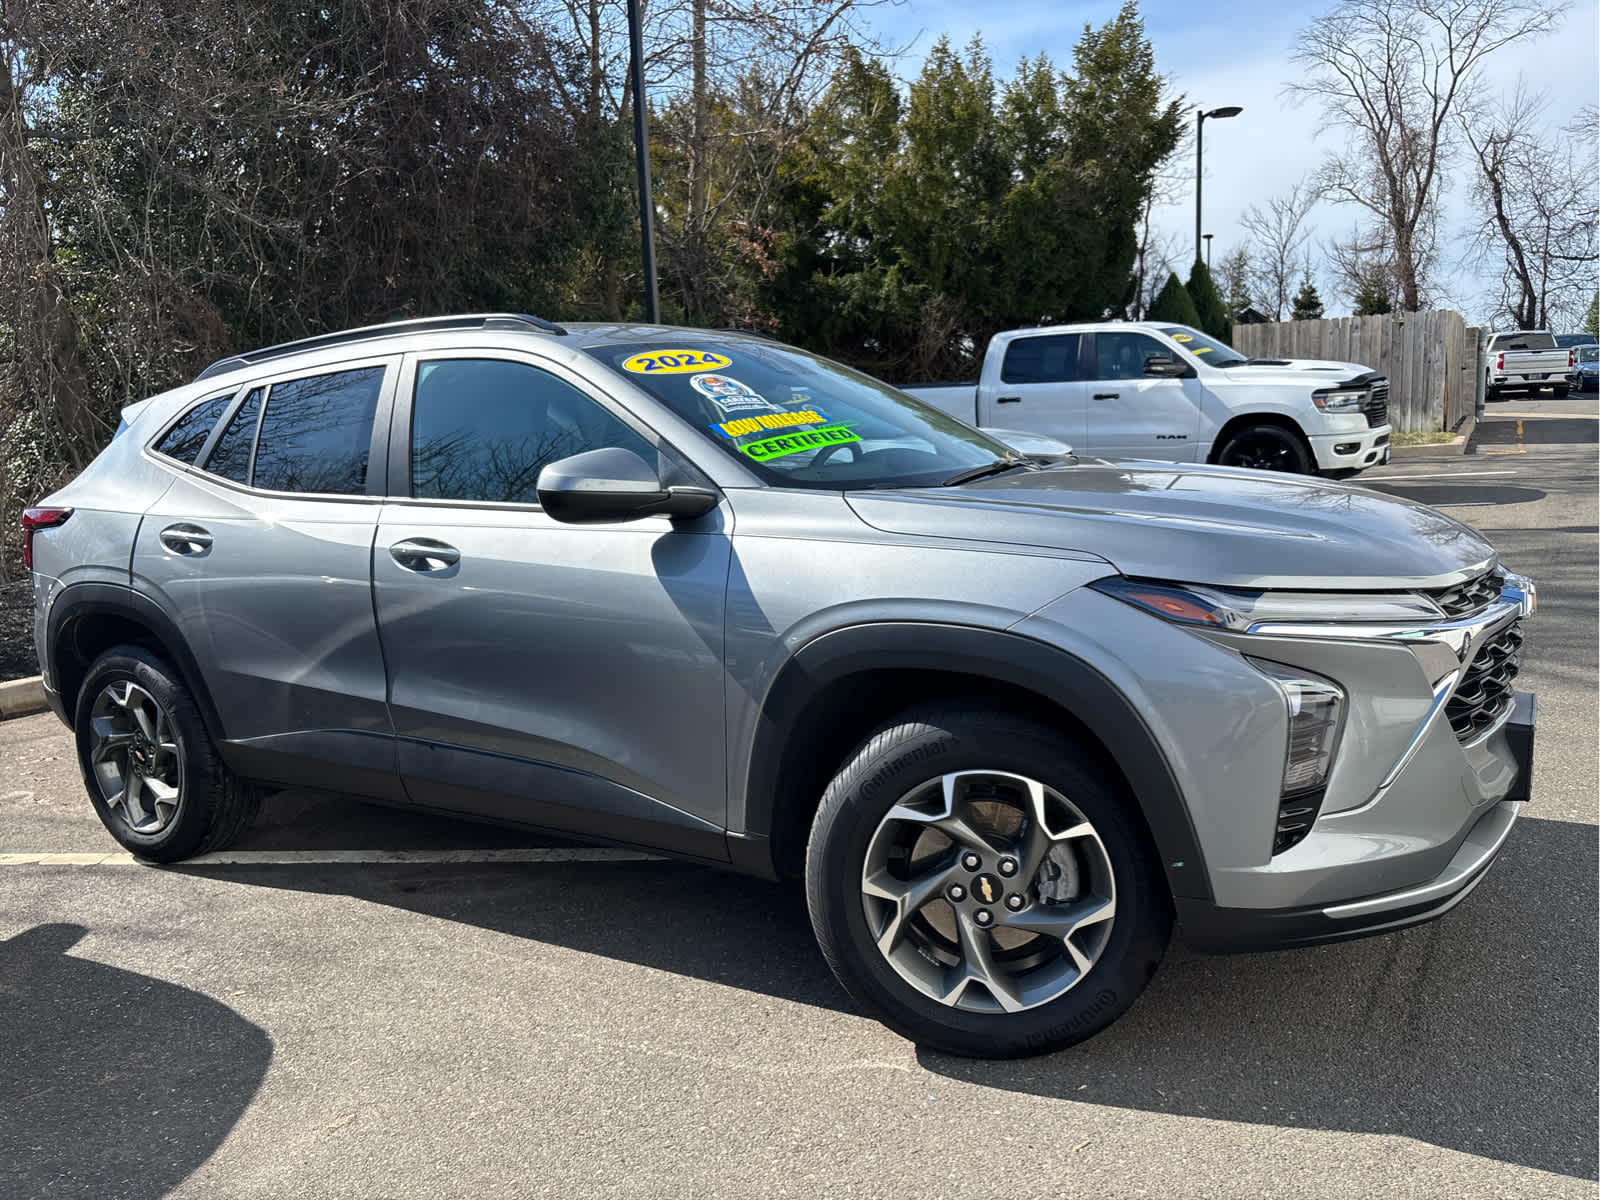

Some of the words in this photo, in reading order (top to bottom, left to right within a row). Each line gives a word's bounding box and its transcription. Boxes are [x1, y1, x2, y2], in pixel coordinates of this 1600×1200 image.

[637, 353, 721, 371] 2024
[719, 417, 763, 438] LOW
[755, 410, 828, 429] MILEAGE
[747, 429, 853, 457] CERTIFIED
